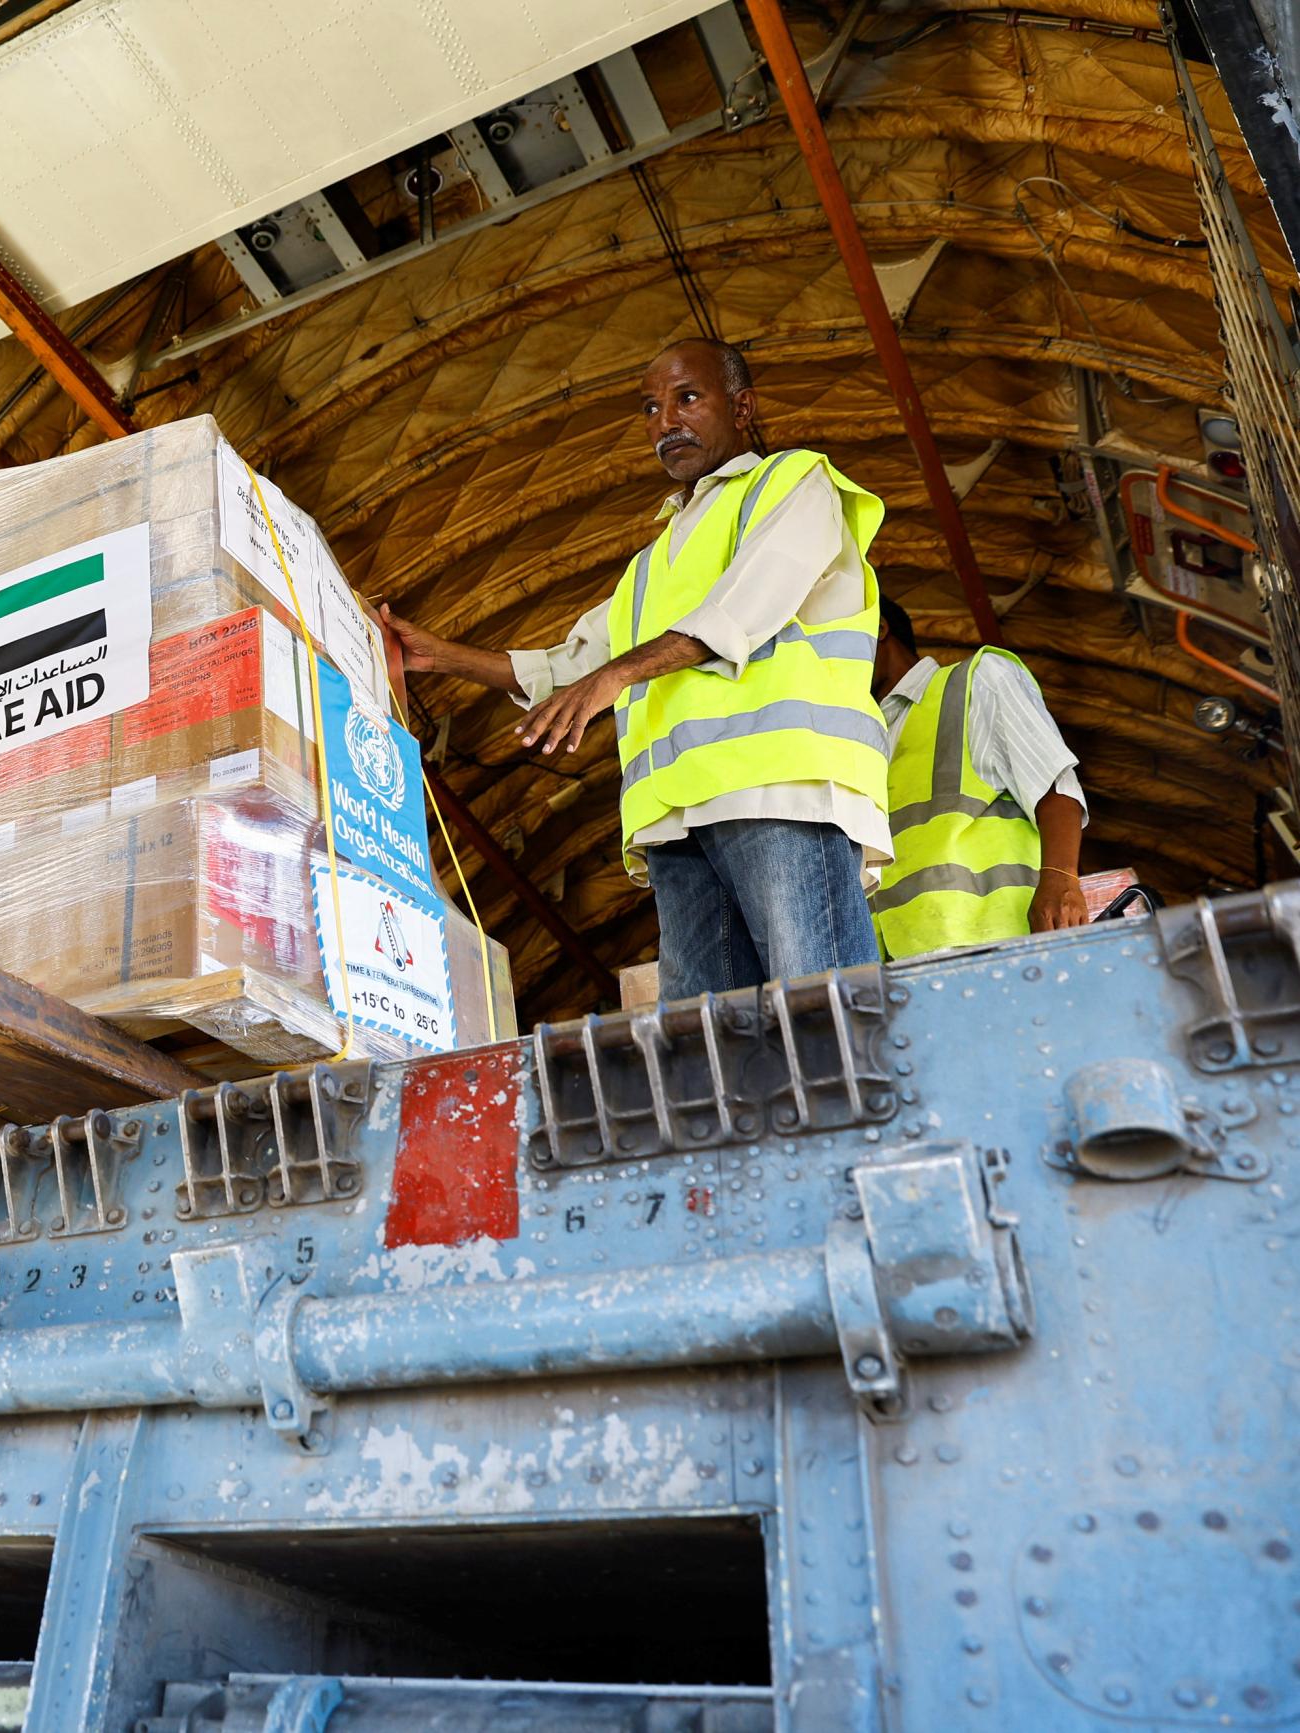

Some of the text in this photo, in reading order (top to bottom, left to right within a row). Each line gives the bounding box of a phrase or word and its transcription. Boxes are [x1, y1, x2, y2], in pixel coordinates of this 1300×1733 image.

[245, 508, 269, 535] PALLET
[248, 533, 267, 556] WHO
[188, 631, 218, 650] BOX
[16, 645, 108, 691] المساعدات
[34, 672, 105, 727] AID
[332, 778, 425, 871] World Health
[160, 833, 173, 846] 12
[335, 814, 437, 899] Organization
[127, 930, 173, 947] etherlands
[346, 963, 365, 975] TIME
[352, 990, 390, 1013] +15°C
[394, 1003, 405, 1020] to
[646, 1193, 666, 1225] 7
[297, 1237, 313, 1263] 5
[23, 1268, 40, 1293] 2
[69, 1265, 87, 1288] 3
